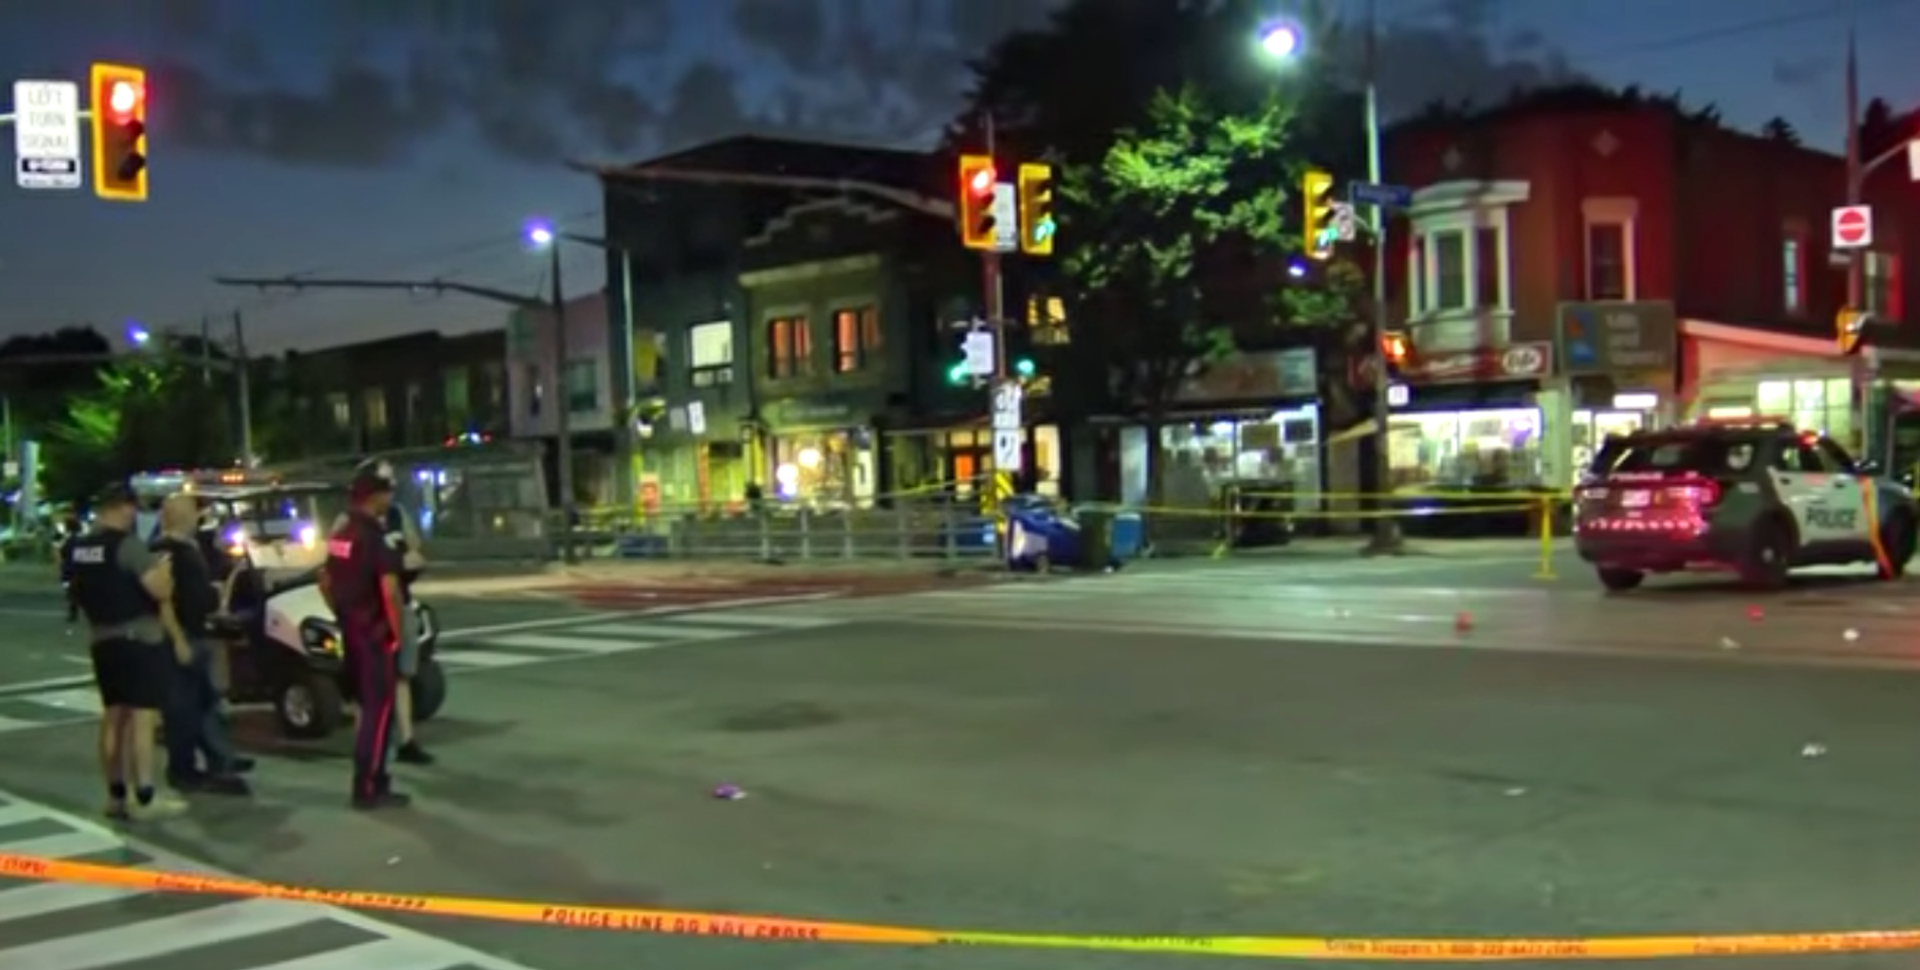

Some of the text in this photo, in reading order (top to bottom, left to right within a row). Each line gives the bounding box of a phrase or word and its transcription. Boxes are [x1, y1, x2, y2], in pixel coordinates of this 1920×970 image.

[1805, 506, 1857, 529] POLICE
[542, 907, 820, 938] POLICE LINE DO NOT CROSS
